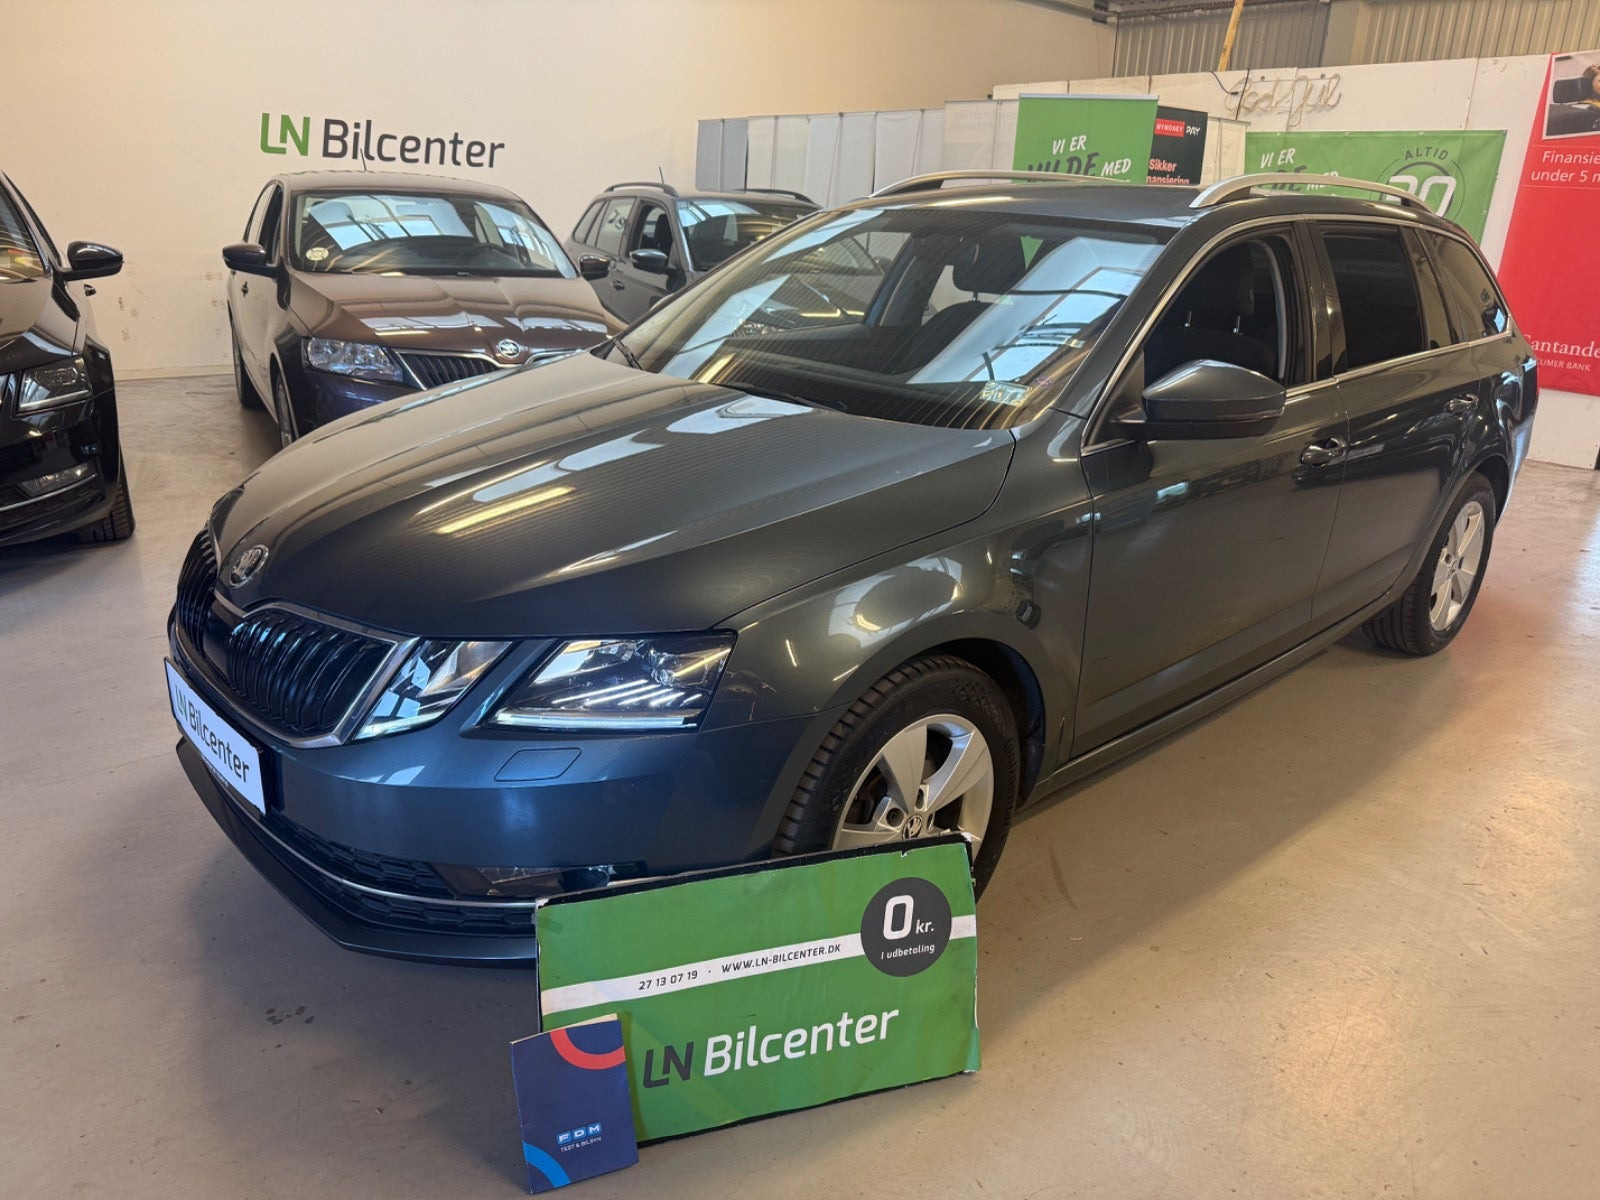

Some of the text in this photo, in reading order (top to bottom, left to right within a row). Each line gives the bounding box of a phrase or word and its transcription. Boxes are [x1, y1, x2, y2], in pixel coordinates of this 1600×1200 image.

[260, 112, 505, 168] LN Bilcenter
[1052, 134, 1086, 155] VI ER
[1260, 147, 1295, 168] VI ER
[1405, 146, 1449, 160] ALTID
[1100, 158, 1131, 176] MED
[1149, 158, 1177, 172] Sikker
[1531, 169, 1574, 182] under
[1579, 170, 1589, 182] 5
[1523, 334, 1600, 358] antande
[1566, 361, 1591, 371] BANK
[175, 684, 188, 721] LN
[188, 700, 249, 783] Bilcenter
[883, 894, 934, 940] 0 kr.
[886, 944, 935, 959] udbetaling
[638, 944, 841, 990] 27 13 07 19 WWW.LN-BILCENTER.DK
[643, 1009, 899, 1088] LN Bilcenter
[558, 1124, 600, 1142] FDM
